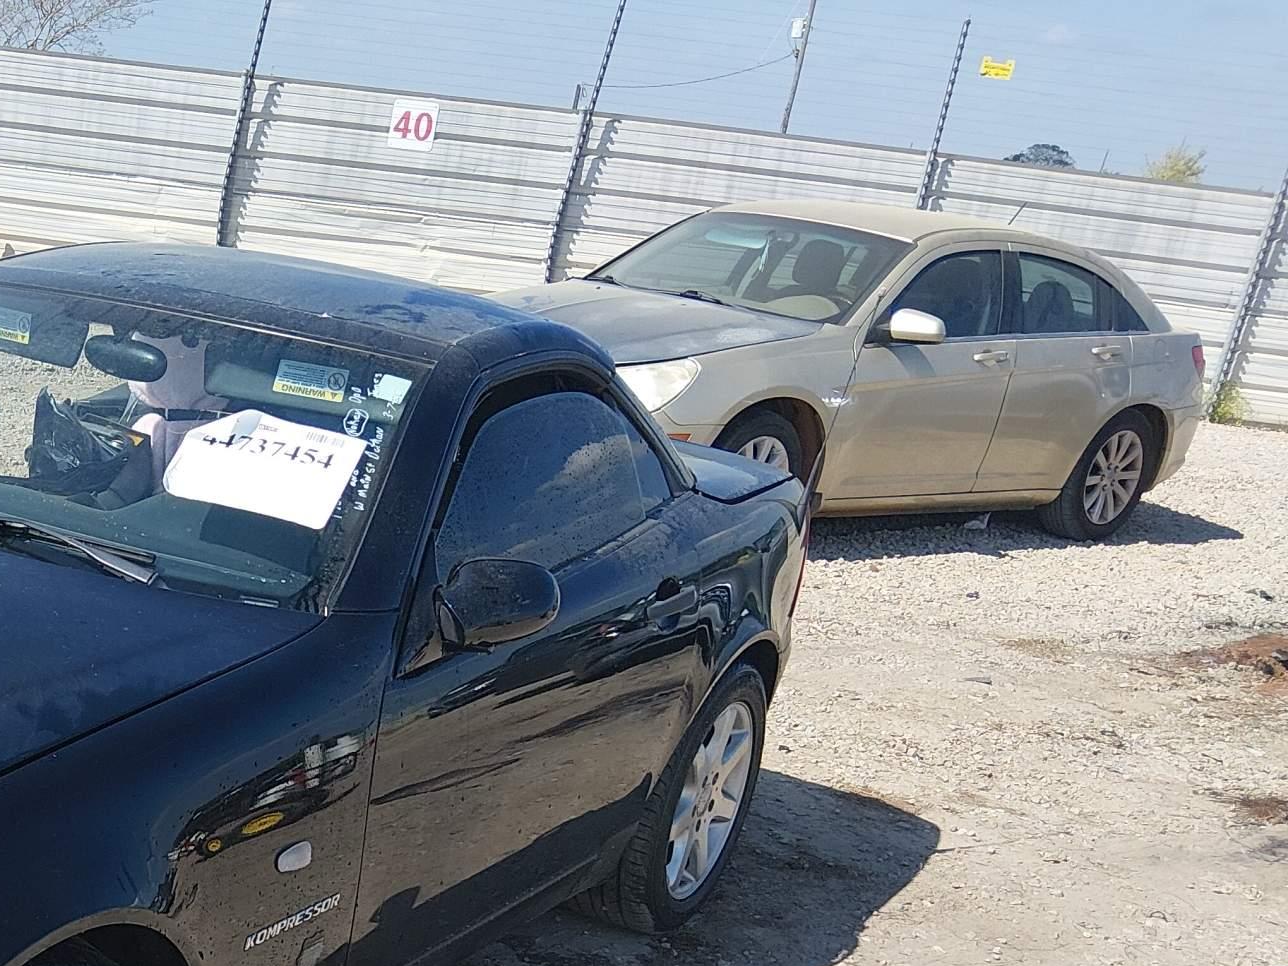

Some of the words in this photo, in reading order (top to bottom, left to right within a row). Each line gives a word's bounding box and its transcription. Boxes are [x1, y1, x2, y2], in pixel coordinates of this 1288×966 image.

[393, 110, 433, 141] 40
[281, 384, 326, 398] WARNING
[202, 433, 335, 469] 44737454
[244, 893, 340, 952] KOMPRESSOR
